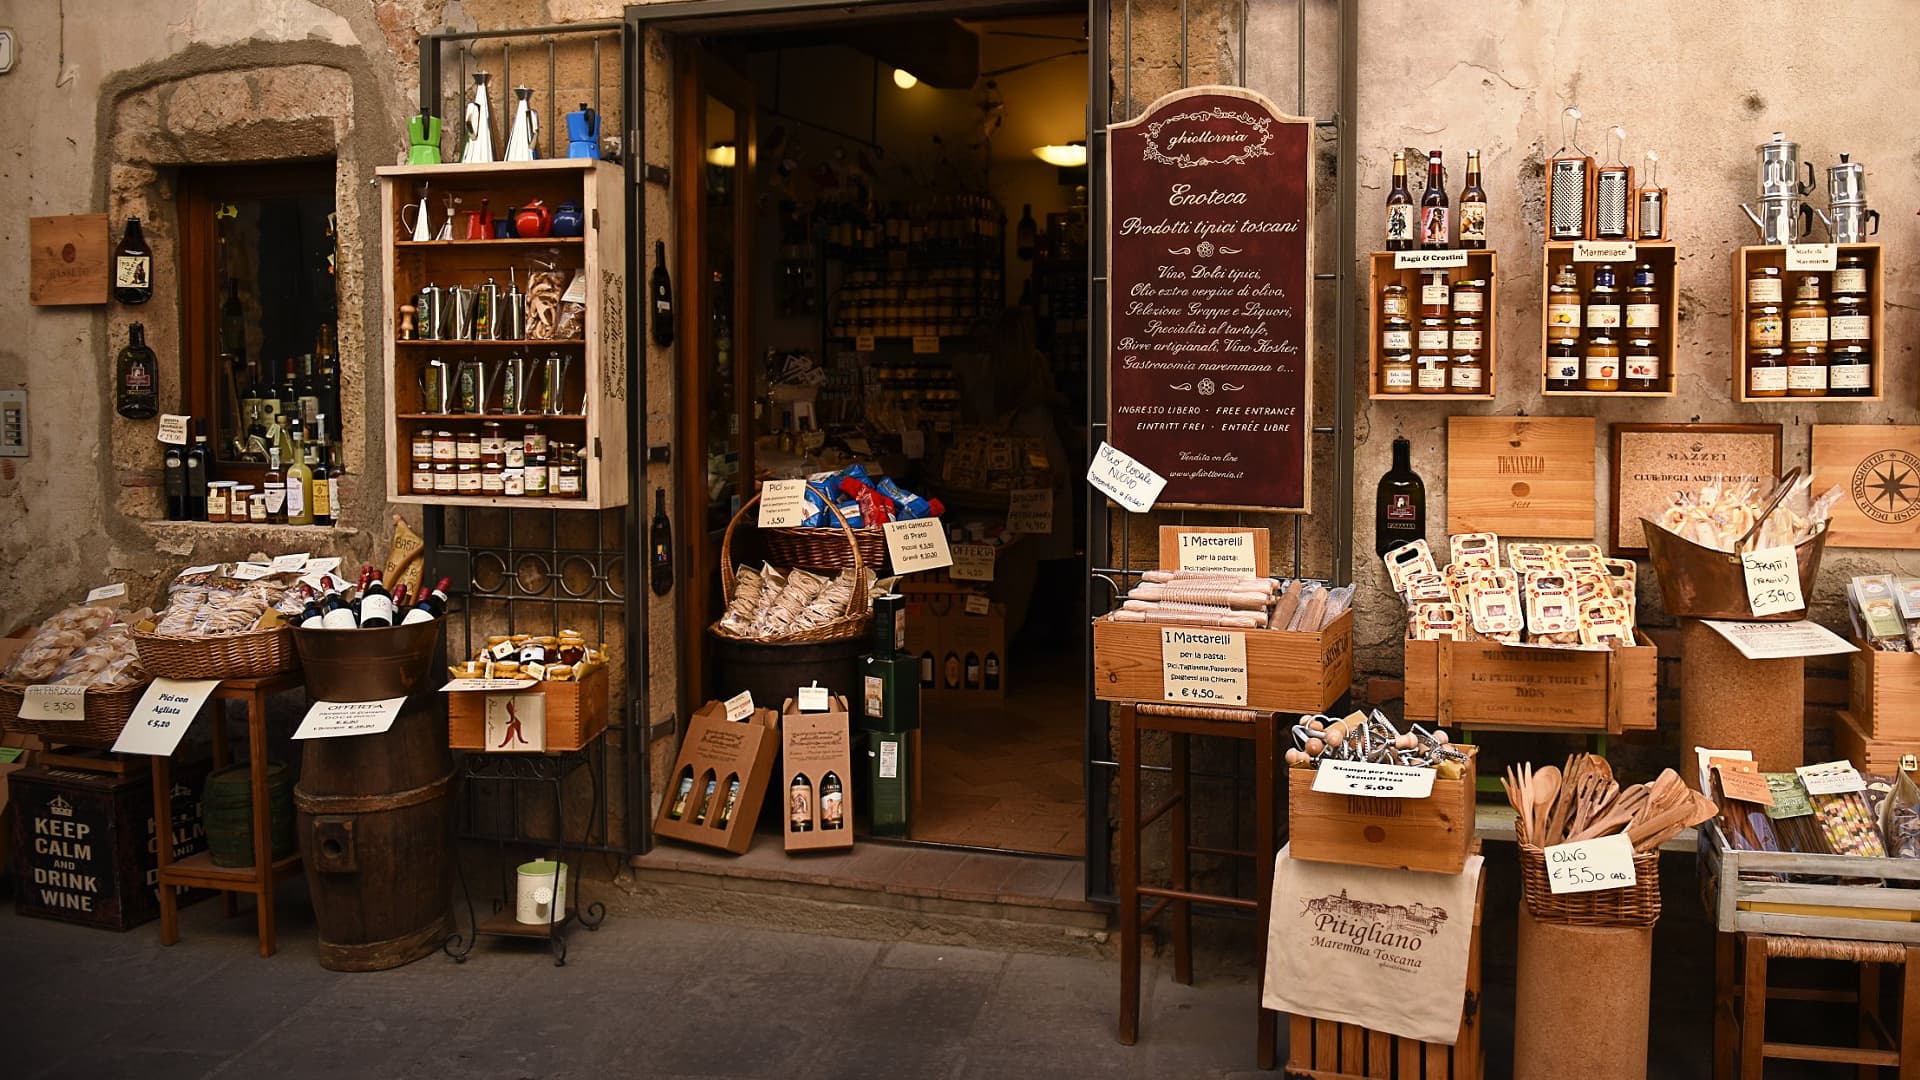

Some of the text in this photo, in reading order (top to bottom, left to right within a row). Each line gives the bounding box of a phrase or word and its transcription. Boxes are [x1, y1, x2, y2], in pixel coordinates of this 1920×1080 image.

[1167, 130, 1248, 150] ghiottornia
[1169, 184, 1247, 206] Enoteca
[1120, 217, 1300, 239] Prodotti tipici toscani
[1400, 255, 1421, 264] Ragù
[1431, 254, 1464, 262] Crostini
[1580, 248, 1627, 258] Marmellate
[1158, 265, 1187, 280] Vino,
[1191, 264, 1227, 280] Dolci
[1130, 282, 1286, 301] Olio extra vergine di oliva,
[1125, 301, 1292, 320] Selezione Grappe e Liquori,
[1143, 320, 1269, 339] Specialità al tartufo,
[1117, 337, 1298, 356] Birre artigianali, Vino Kosher,
[1122, 356, 1196, 370] Gastronomia
[1196, 361, 1272, 372] maremmana
[1118, 405, 1296, 416] INGRESSO LIBERO FREE ENTRANCE
[1136, 420, 1291, 433] EINTRITT FREI ENTRÉE LIBRE
[1178, 451, 1211, 462] Vendita
[1497, 455, 1545, 474] TIGNANELLO
[1667, 453, 1726, 461] MAZZEI
[1108, 466, 1138, 490] NUOVO
[1125, 460, 1153, 486] locale
[1633, 474, 1659, 482] CLUB
[1660, 474, 1688, 482] DEGLI
[1183, 535, 1243, 547] I Mattarelli
[1165, 631, 1230, 645] I Mattarelli
[1180, 651, 1227, 661] per la pasta:
[158, 693, 189, 704] Pici con
[1181, 687, 1190, 698] €
[1191, 687, 1215, 699] 4,50
[152, 705, 181, 715] Agliata
[34, 816, 92, 841] KEEP
[34, 837, 92, 861] CALM
[53, 858, 77, 871] AND
[34, 867, 99, 894] DRINK
[40, 888, 94, 913] WINE
[1313, 913, 1422, 951] Pitigliano
[1310, 935, 1423, 968] Maremma Toscana
